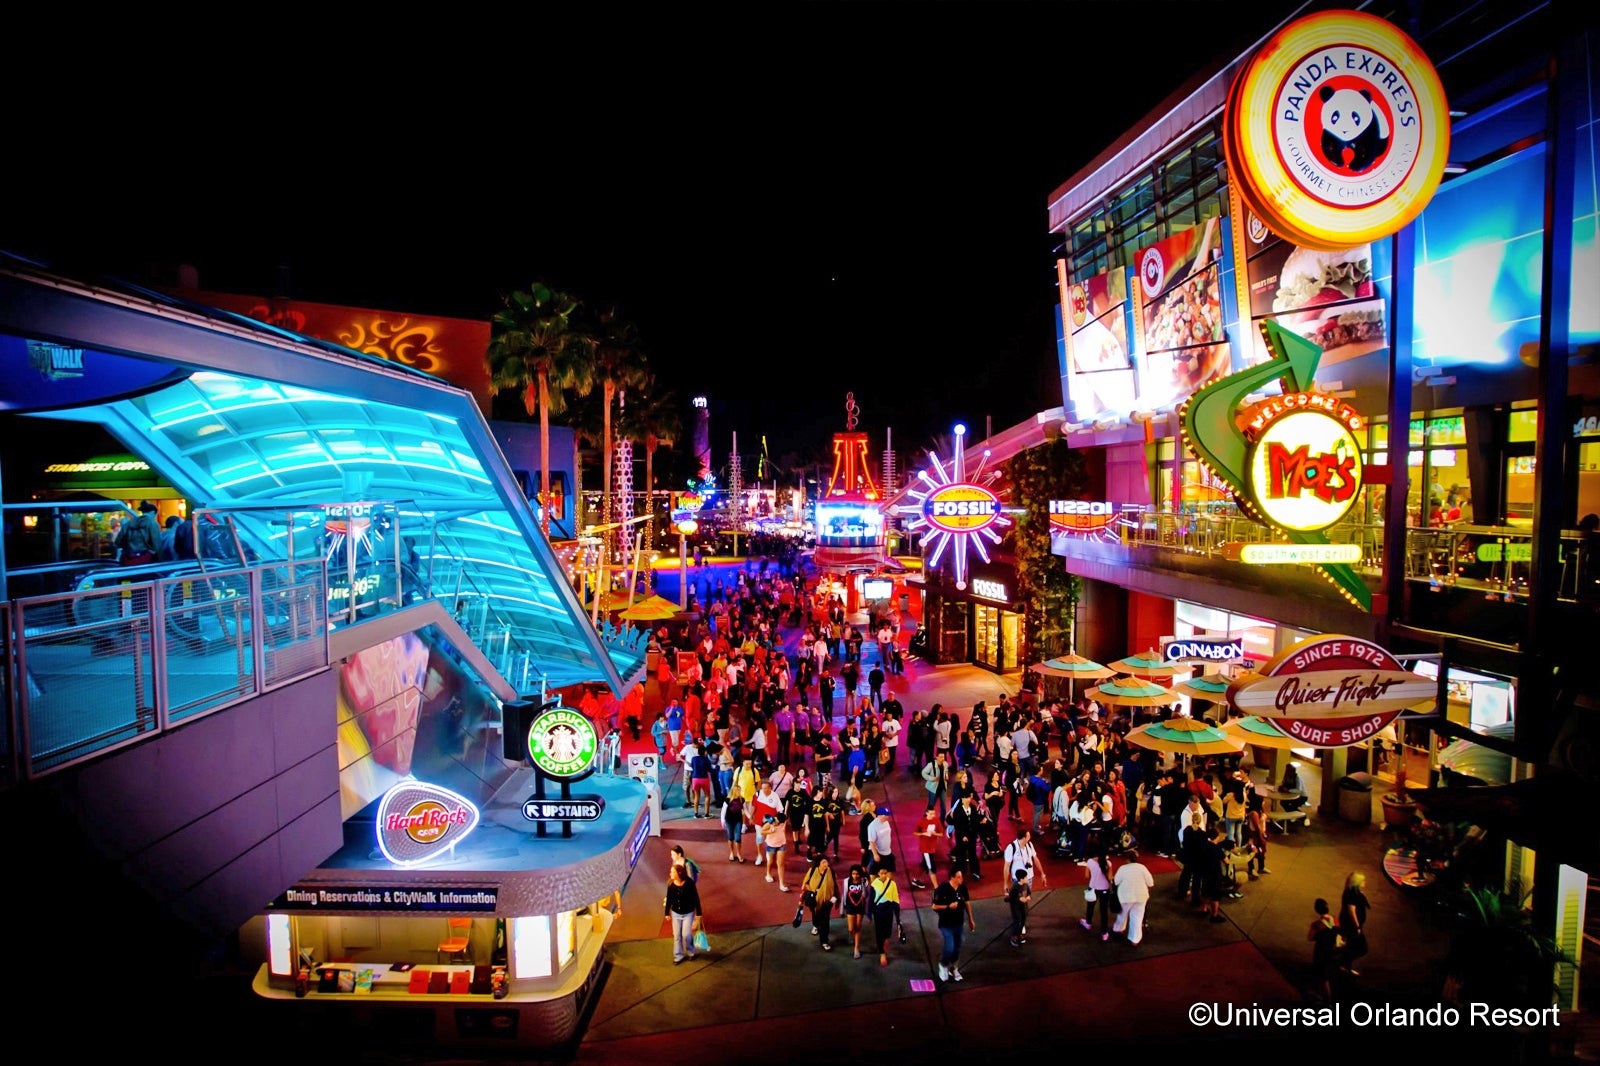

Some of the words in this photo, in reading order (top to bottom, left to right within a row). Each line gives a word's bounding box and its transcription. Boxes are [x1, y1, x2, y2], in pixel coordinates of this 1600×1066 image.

[1284, 55, 1337, 122] PANDA
[1346, 52, 1416, 127] EXPRESS
[1287, 136, 1332, 193] GOURMET
[1338, 178, 1390, 198] CHINESE
[51, 347, 84, 369] WALK
[1251, 394, 1335, 428] WELCOME
[1341, 408, 1361, 429] TO
[44, 462, 115, 473] STARBUCKS
[933, 501, 995, 515] FOSSIL
[1250, 548, 1319, 560] southwest
[1324, 547, 1354, 561] grill
[973, 579, 1008, 600] FOSSIL
[1167, 643, 1244, 660] CINNABON
[1294, 643, 1342, 669] SINCE
[1349, 643, 1385, 667] 1972
[1275, 677, 1335, 715] Quiet
[1332, 673, 1405, 708] Flight
[532, 713, 593, 739] STARBUCKS
[1291, 720, 1331, 743] SURF
[1341, 716, 1382, 743] SHOP
[539, 755, 586, 773] COFFEE
[387, 809, 428, 831] Hard
[429, 806, 466, 828] Rock
[542, 804, 597, 818] UPSTAIRS
[286, 890, 317, 905] Dining
[319, 890, 382, 903] Reservations
[383, 891, 391, 902] &
[393, 891, 437, 905] CityWalk
[439, 892, 496, 904] Information
